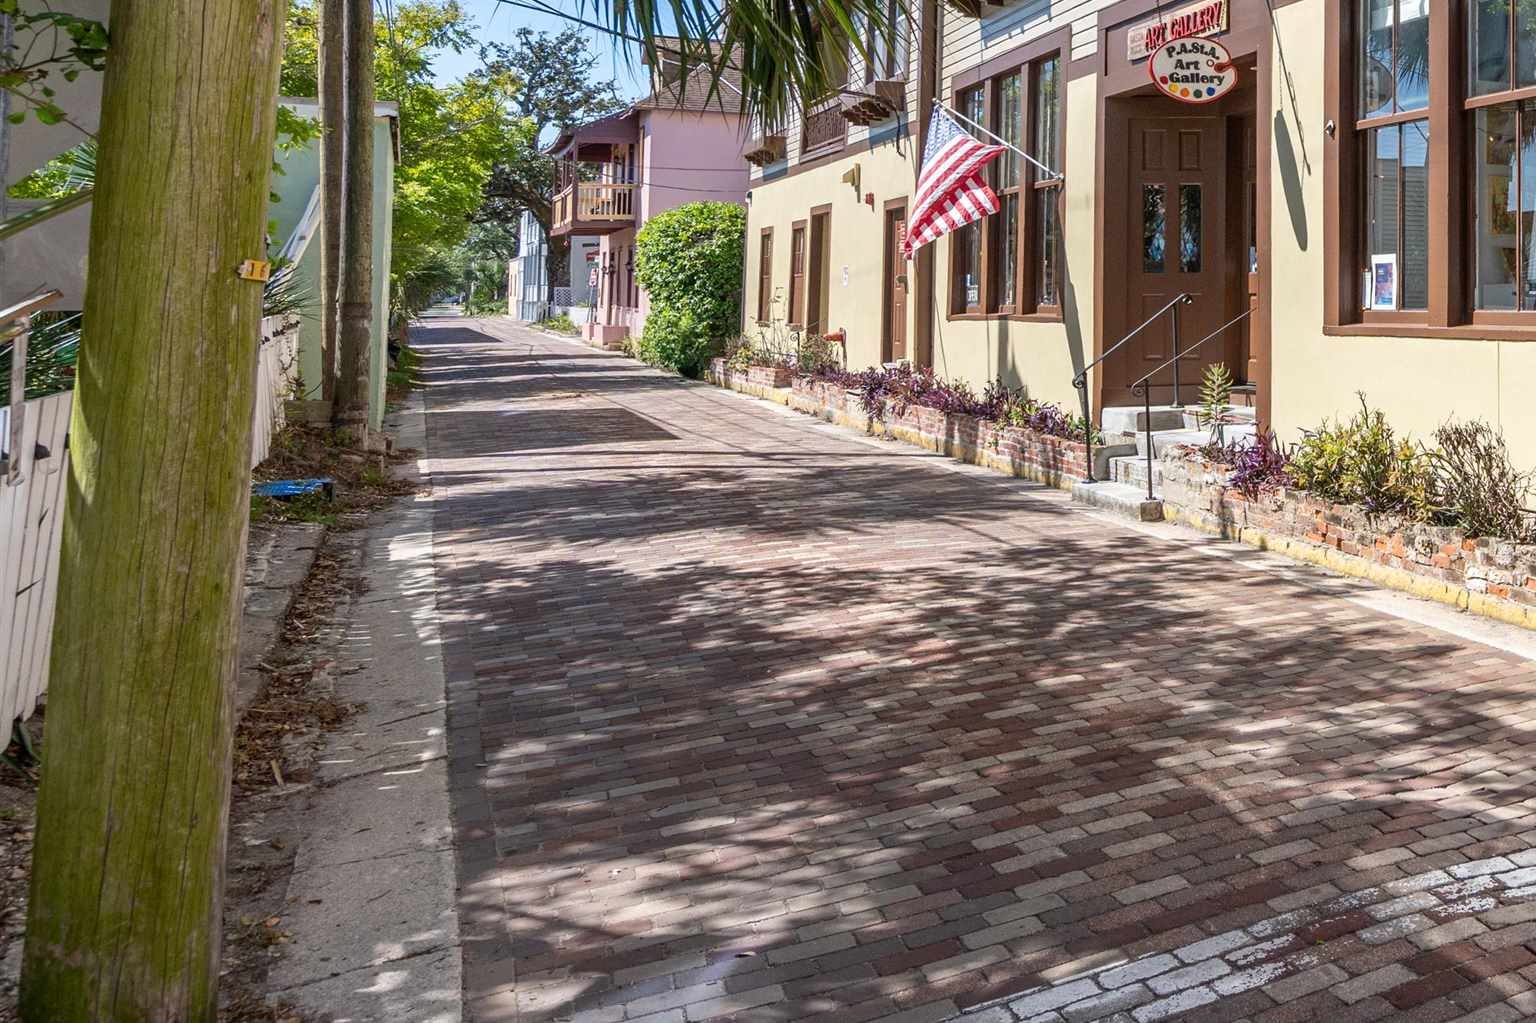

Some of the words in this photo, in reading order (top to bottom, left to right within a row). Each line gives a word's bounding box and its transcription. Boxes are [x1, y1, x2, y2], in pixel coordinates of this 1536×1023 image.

[1145, 22, 1167, 52] ART
[1170, 1, 1222, 38] GALLERY
[1174, 59, 1200, 71] Art
[1168, 72, 1225, 86] Gallery
